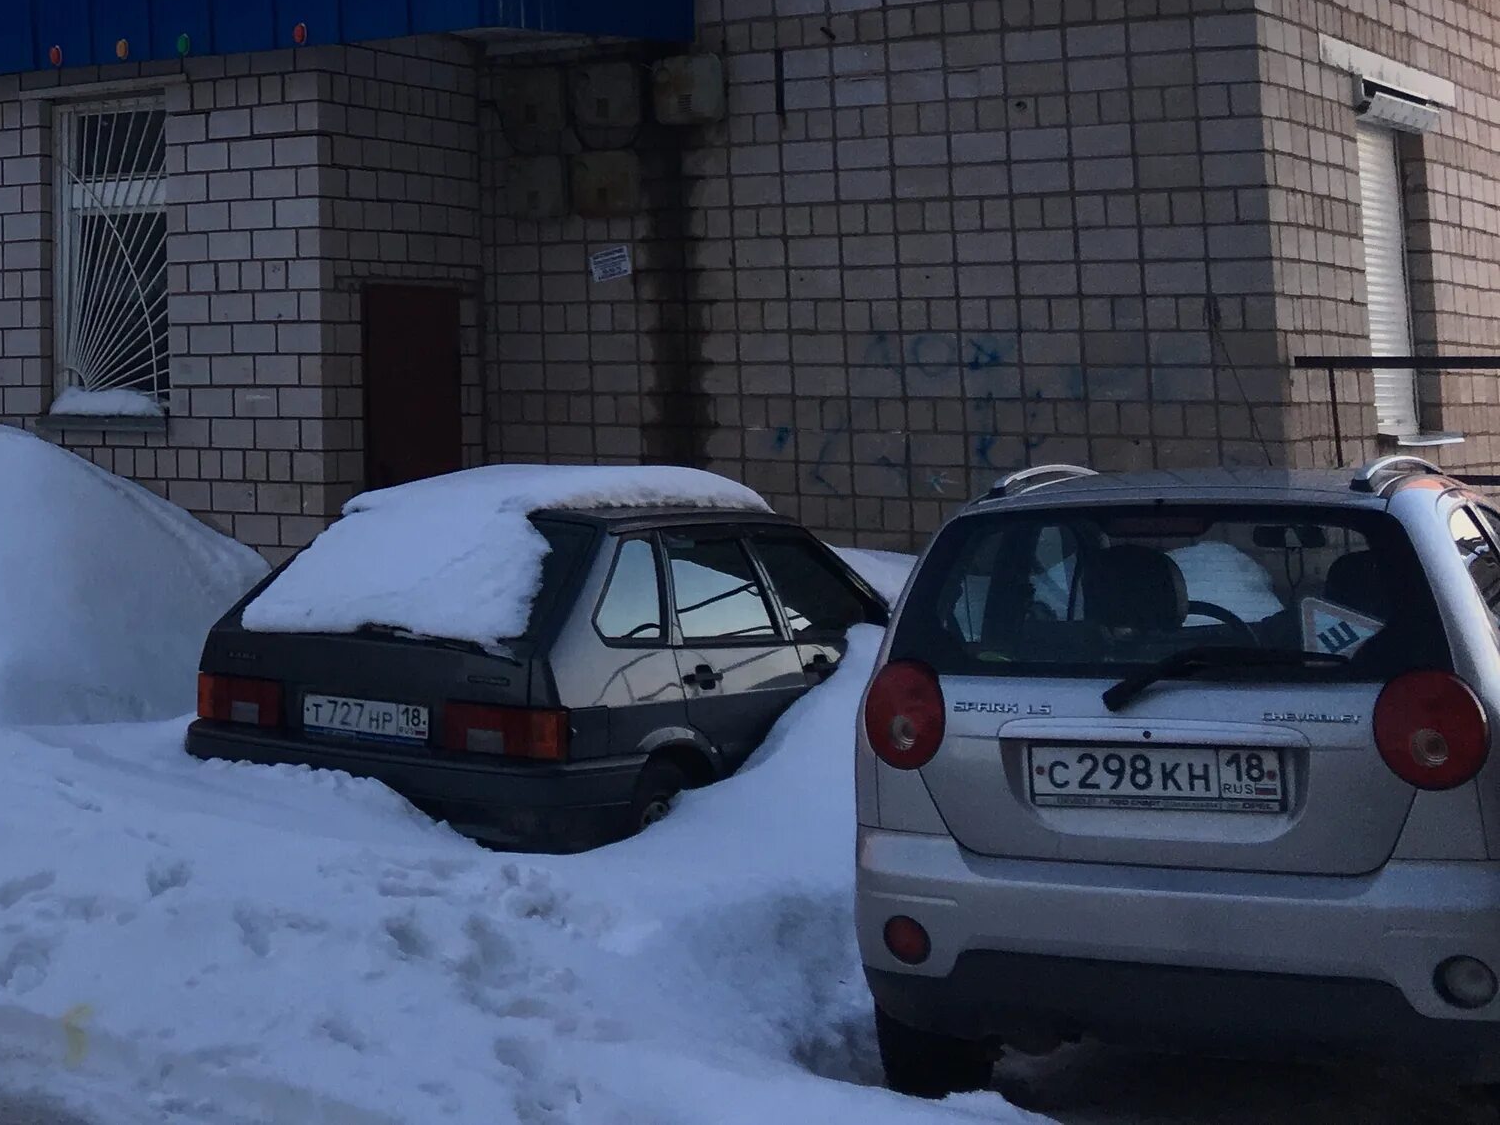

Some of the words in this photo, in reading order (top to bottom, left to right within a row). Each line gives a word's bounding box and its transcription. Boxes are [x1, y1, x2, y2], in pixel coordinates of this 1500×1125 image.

[954, 701, 1019, 715] SPARK
[1027, 704, 1052, 716] LS
[1263, 712, 1362, 725] CHEVROLET
[1225, 752, 1265, 783] 18
[1223, 782, 1254, 795] RUS
